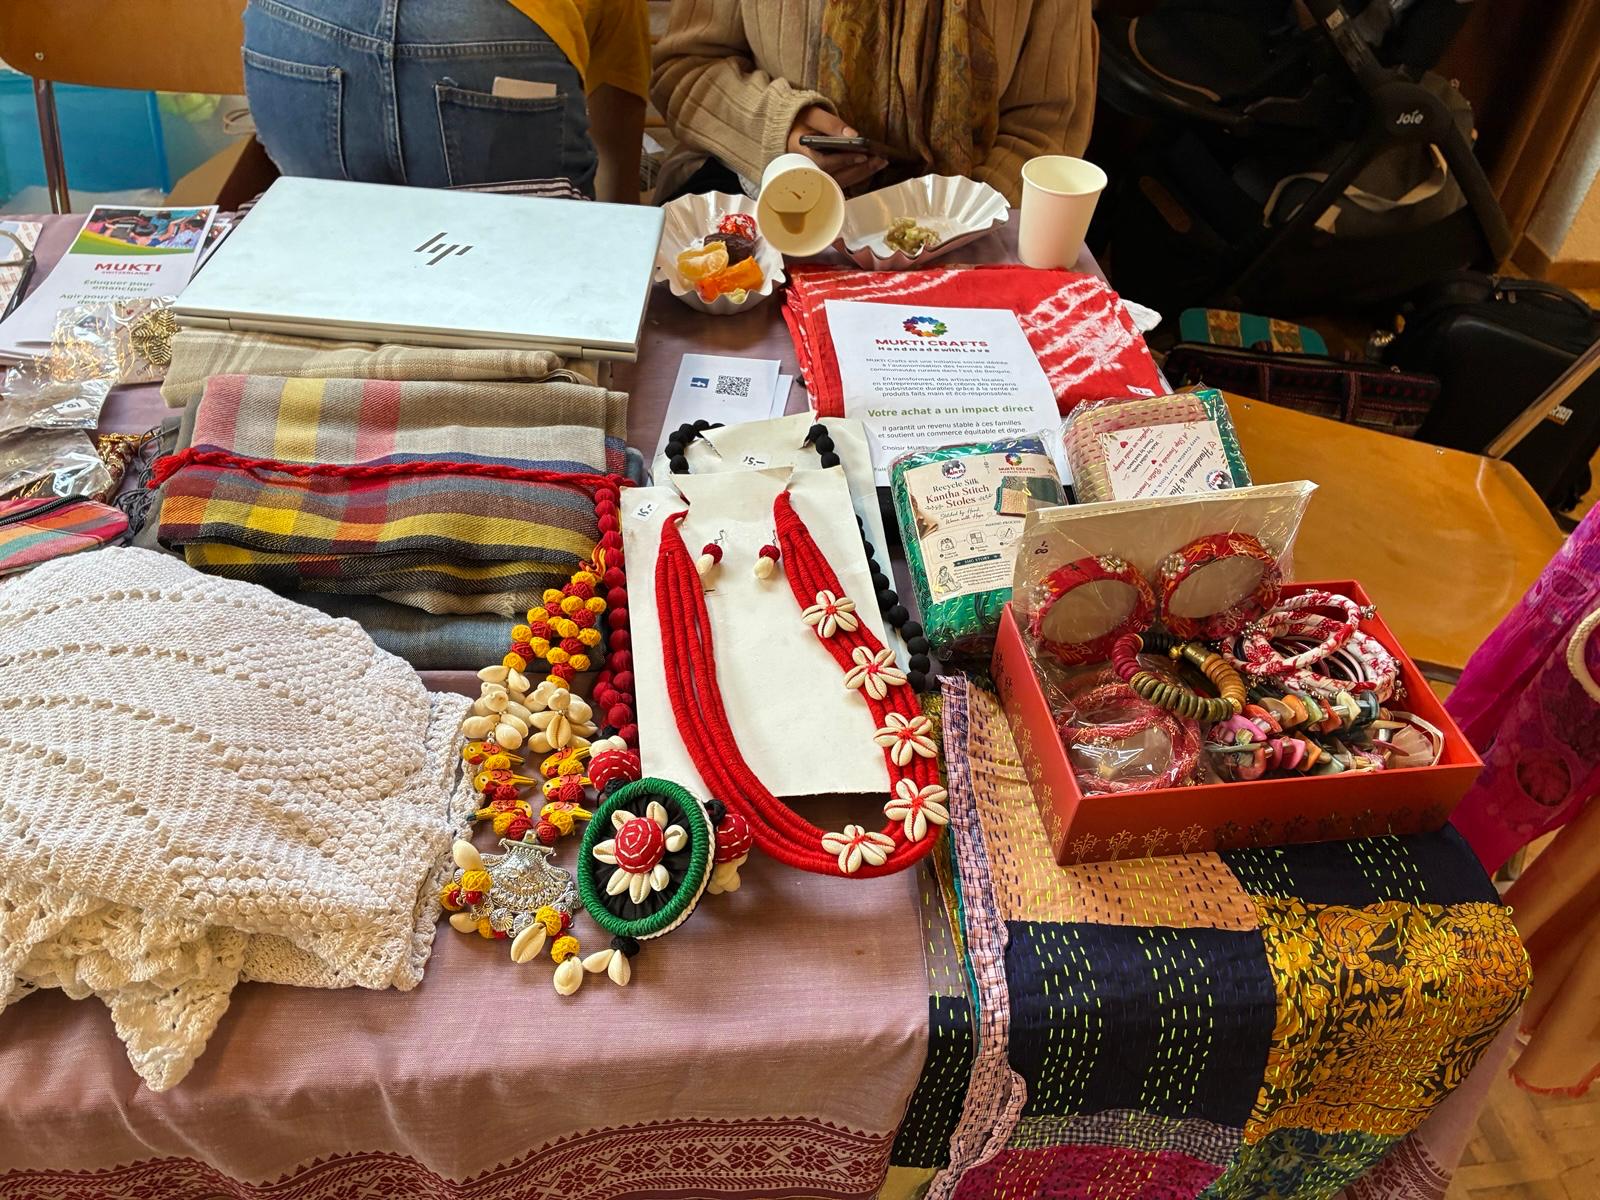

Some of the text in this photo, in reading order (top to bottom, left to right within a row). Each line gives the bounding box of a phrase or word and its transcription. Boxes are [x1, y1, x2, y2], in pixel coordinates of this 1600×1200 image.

[1396, 110, 1424, 125] Joie
[94, 263, 162, 272] MUKTI
[867, 408, 900, 418] Votre
[901, 407, 932, 416] achat
[961, 406, 999, 415] impact
[1001, 404, 1034, 414] direct
[888, 424, 915, 433] garantit
[994, 419, 1022, 427] familles
[964, 426, 996, 436] équitable
[1007, 426, 1026, 434] digne.
[1151, 441, 1161, 450] Made
[1174, 436, 1185, 448] Step
[743, 456, 766, 466] 15.-
[1133, 451, 1141, 461] kind
[1184, 446, 1213, 479] Handmade
[1147, 467, 1162, 481] Better
[1179, 476, 1187, 484] is
[932, 481, 962, 493] Recycle
[964, 477, 980, 486] Silk
[926, 484, 990, 504] Kantha Stitch
[945, 497, 977, 509] Stoles
[637, 503, 653, 517] 15.-
[959, 509, 965, 517] by
